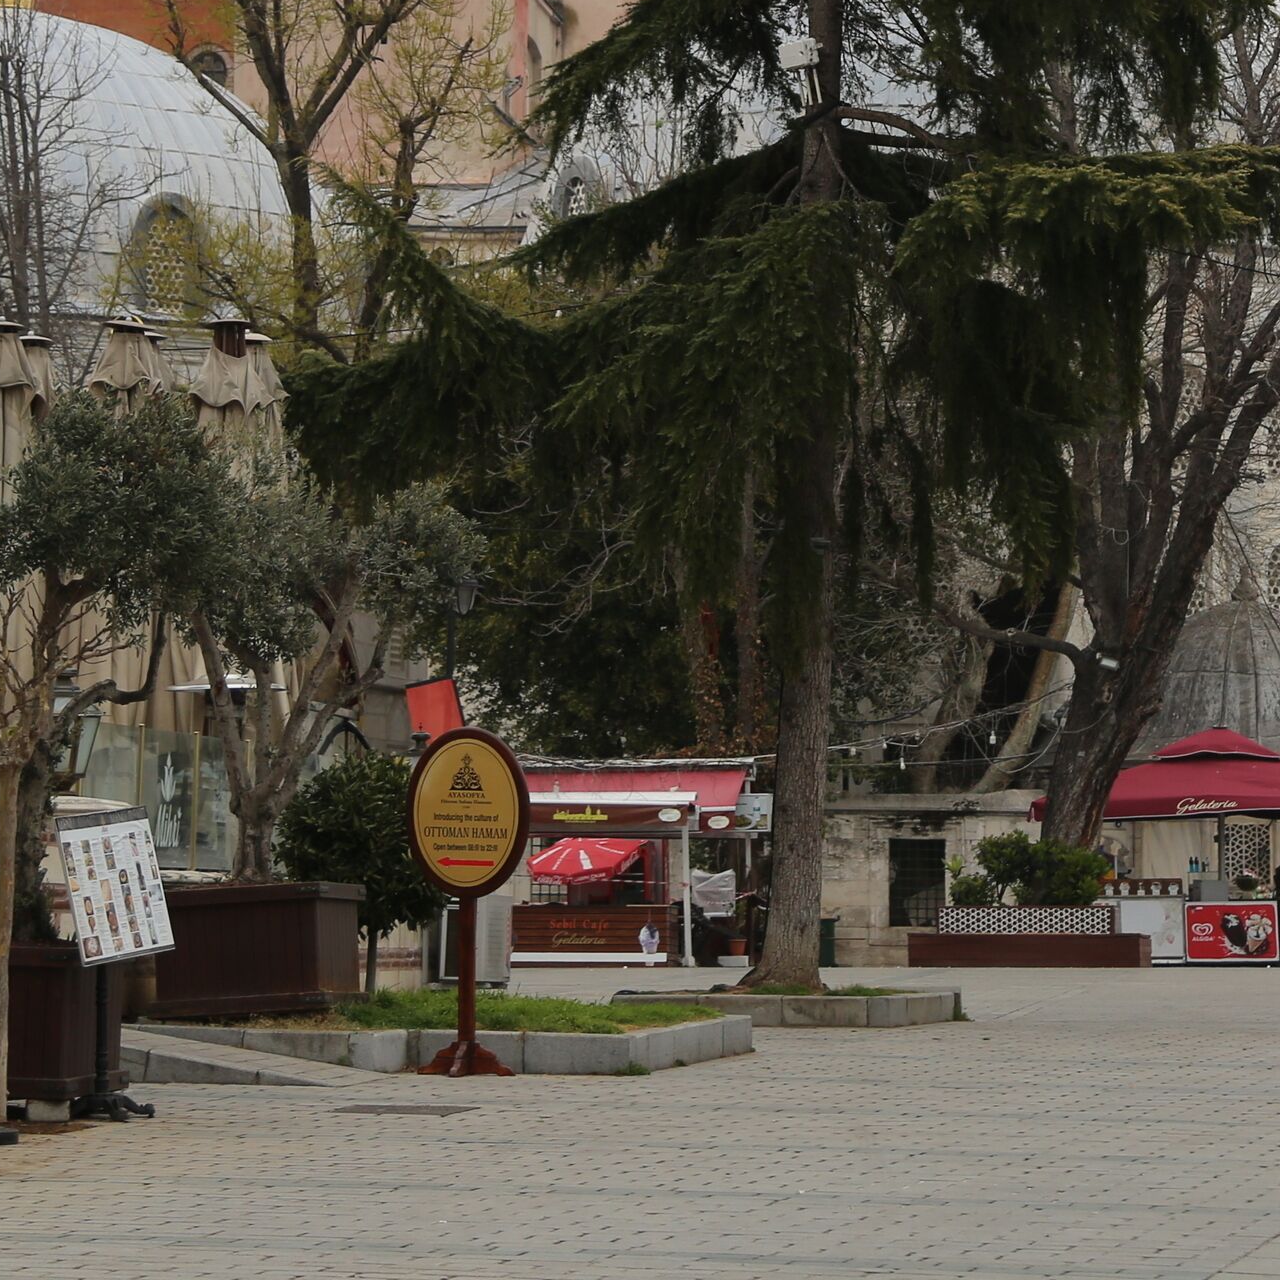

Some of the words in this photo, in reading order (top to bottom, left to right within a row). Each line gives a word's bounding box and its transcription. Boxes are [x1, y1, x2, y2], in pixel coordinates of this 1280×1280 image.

[1175, 797, 1238, 815] Gelateria
[423, 826, 470, 838] OTTOMAN
[471, 827, 508, 839] HAMAM
[551, 930, 608, 948] Gelateria
